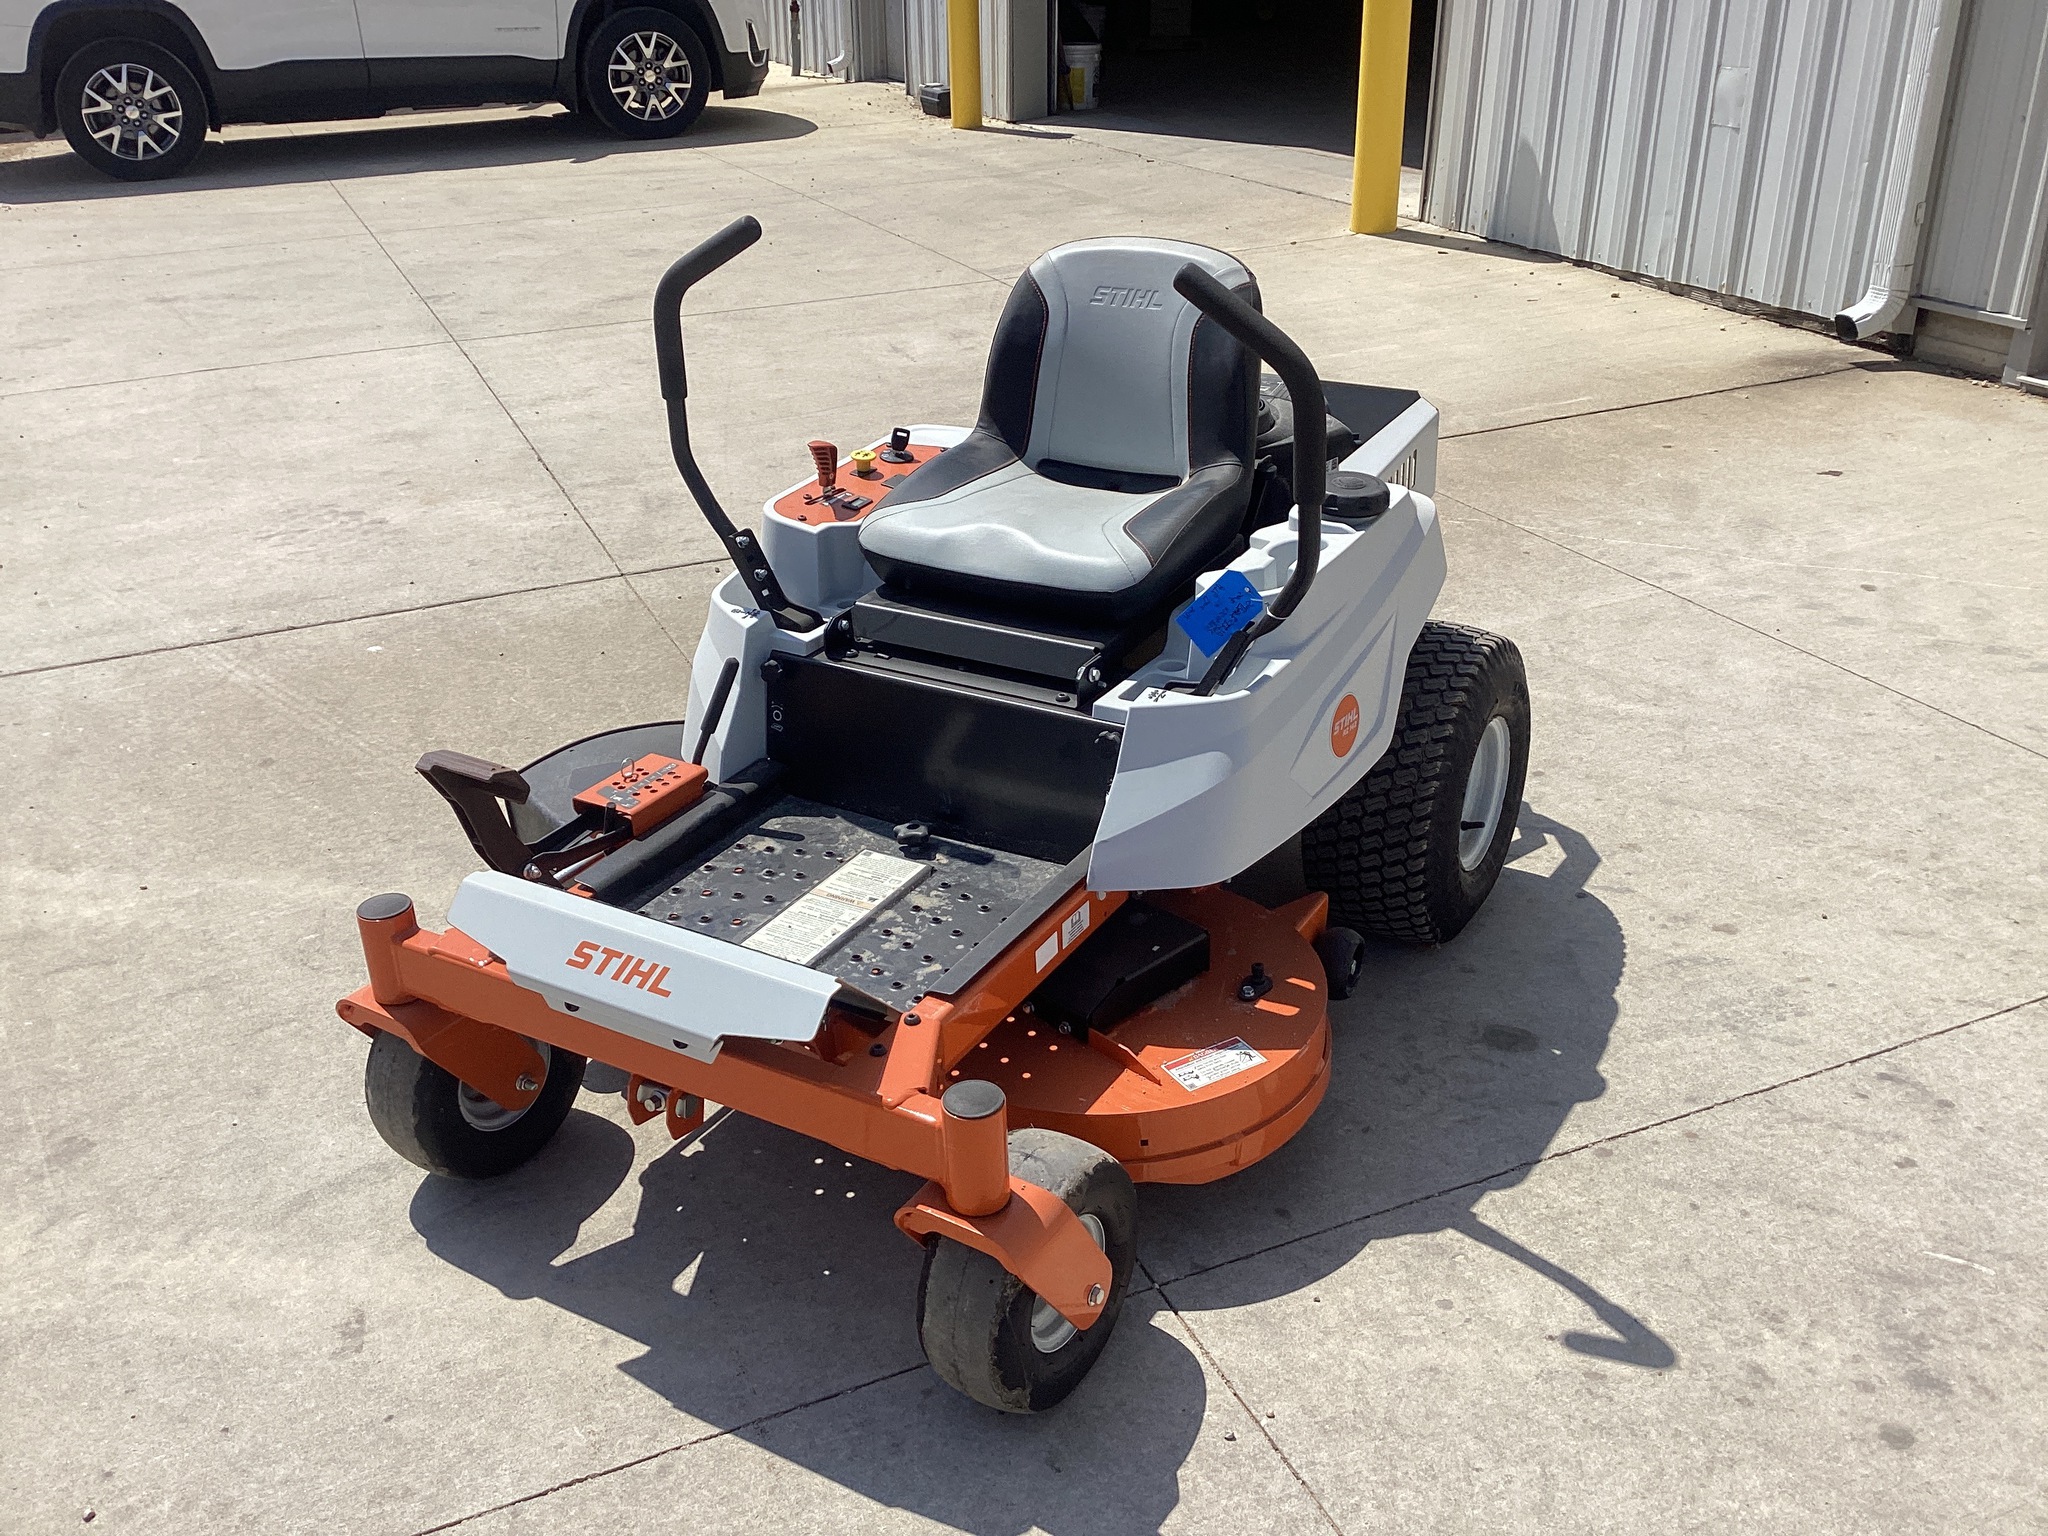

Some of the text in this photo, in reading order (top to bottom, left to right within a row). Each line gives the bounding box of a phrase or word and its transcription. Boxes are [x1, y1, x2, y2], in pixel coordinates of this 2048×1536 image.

[1089, 285, 1164, 311] STIHL
[1333, 707, 1359, 736] STIHL
[565, 940, 672, 998] STIHL
